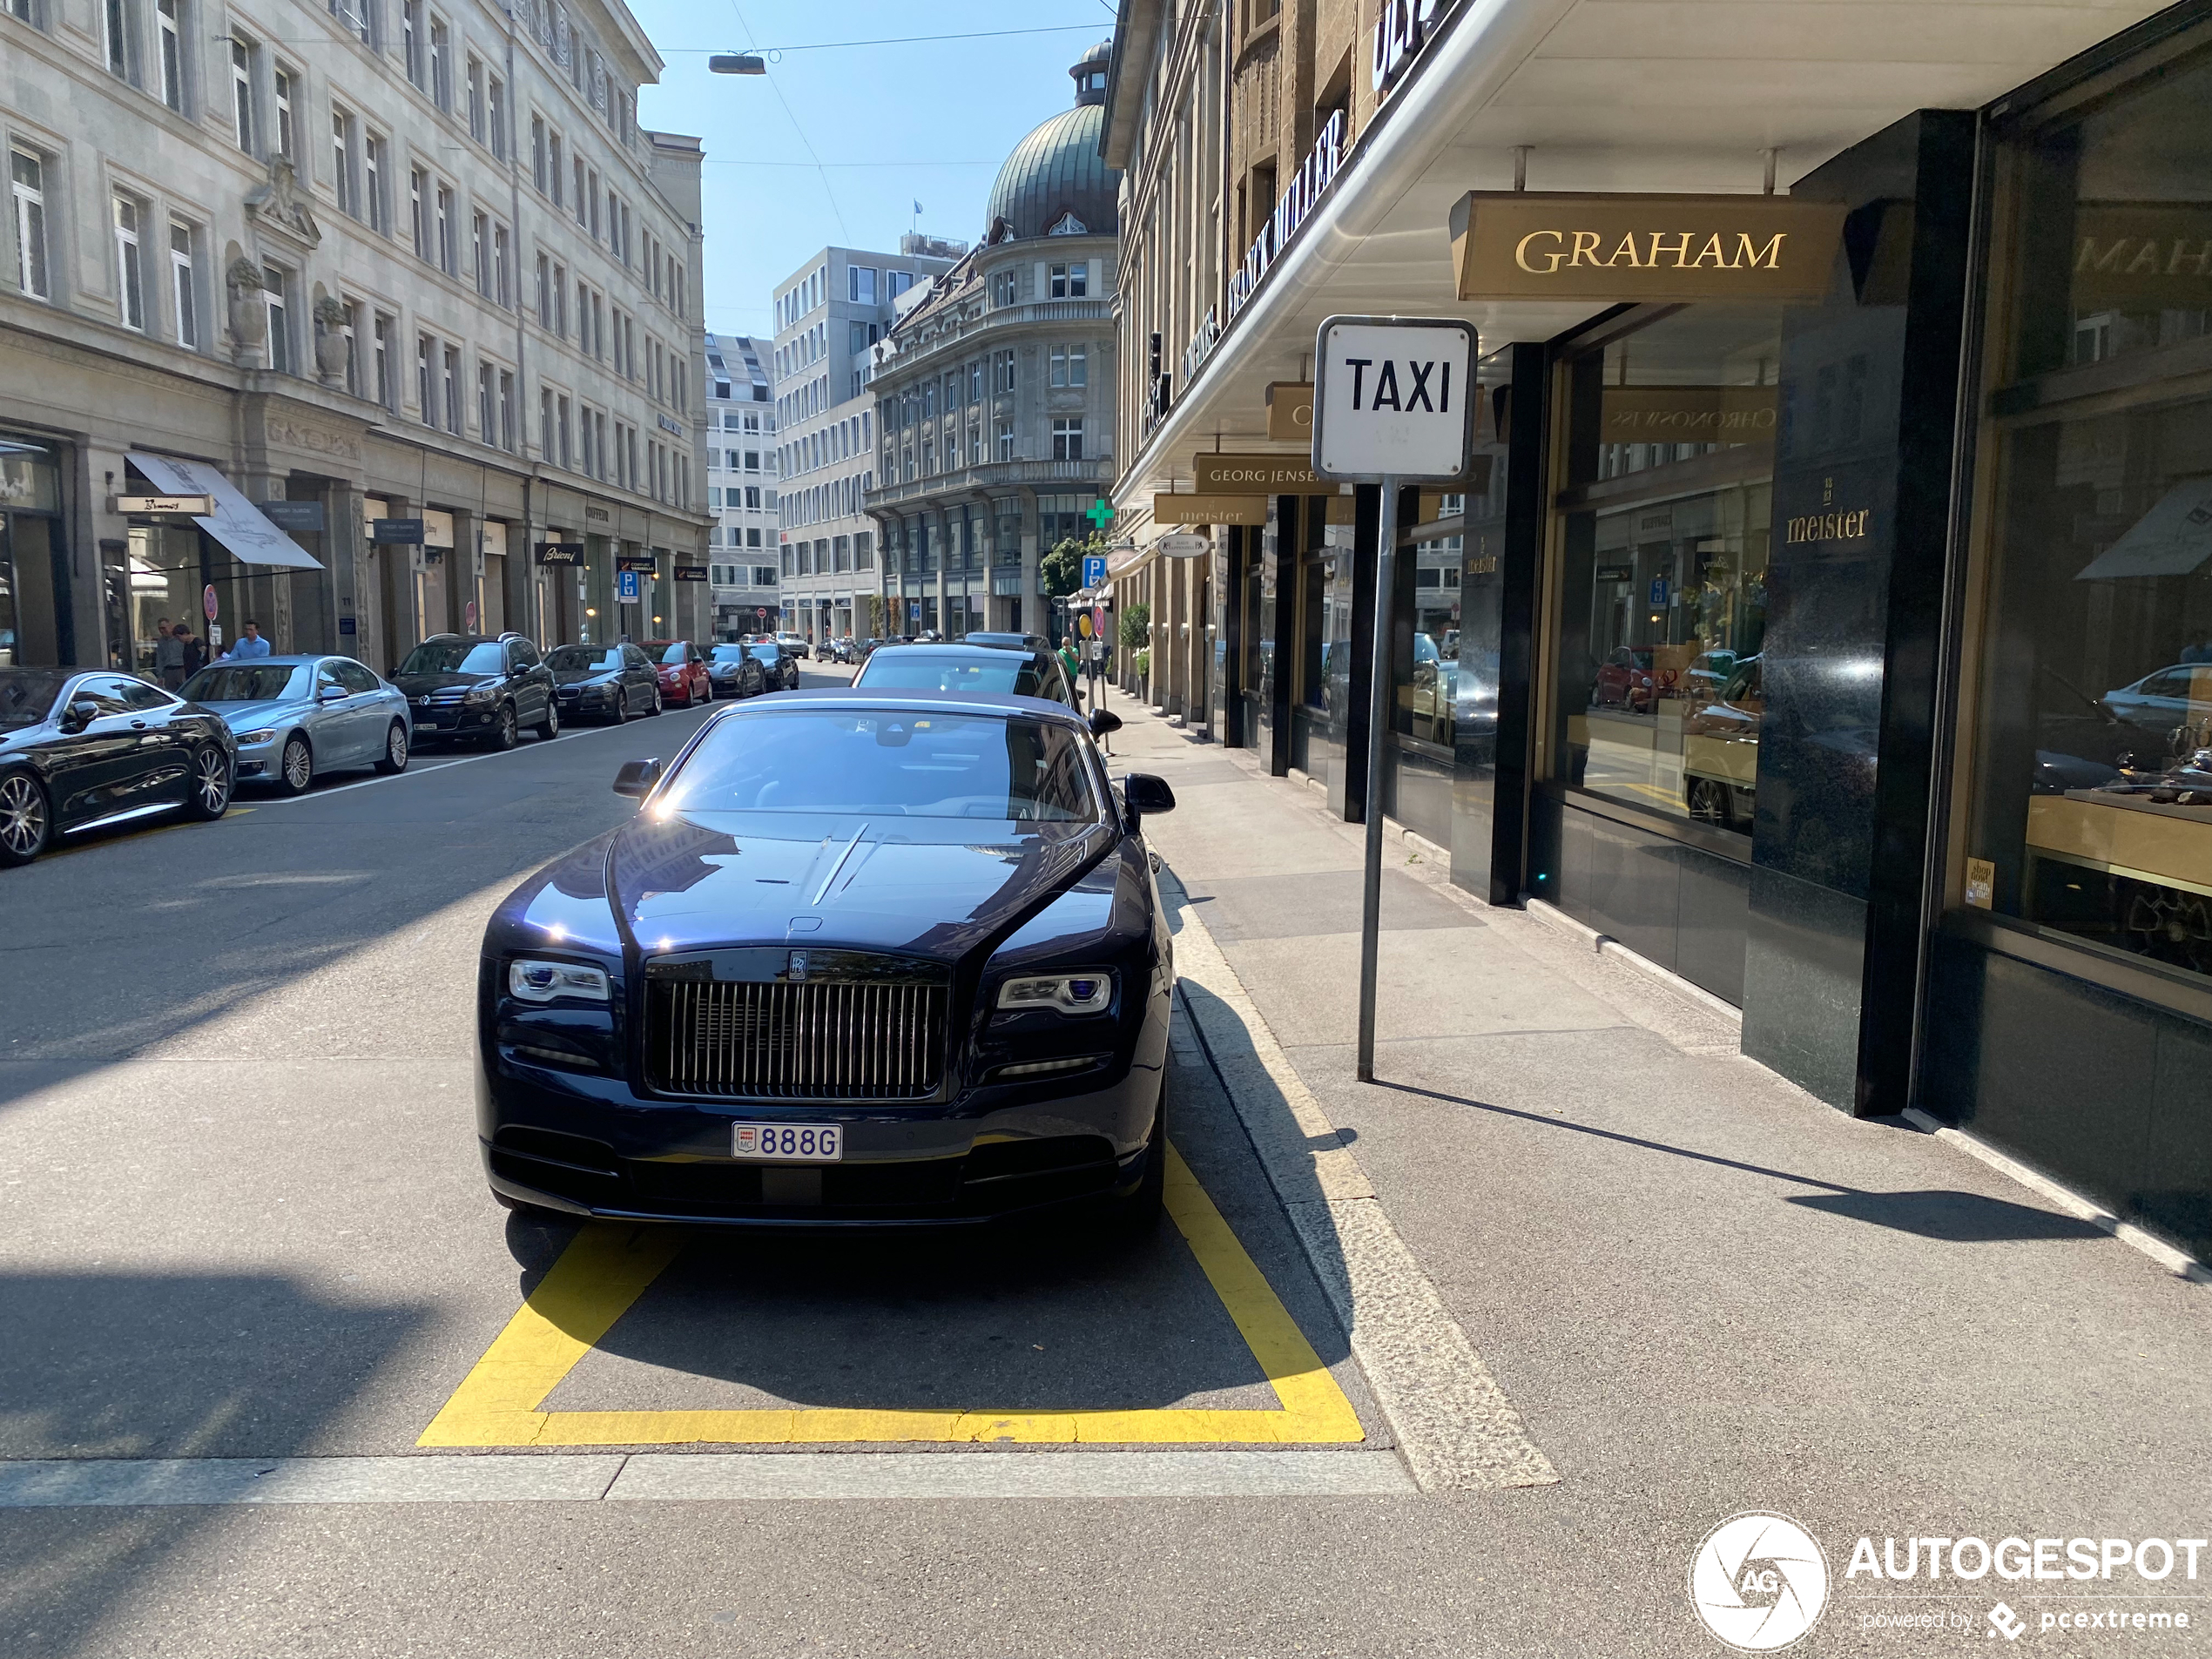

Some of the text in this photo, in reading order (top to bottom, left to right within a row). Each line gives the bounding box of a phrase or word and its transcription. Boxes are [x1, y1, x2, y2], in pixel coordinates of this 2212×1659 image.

[1229, 109, 1342, 320] FRANCK MULLER
[1514, 231, 1787, 273] GRAHAM
[1345, 358, 1450, 413] TAXI
[1211, 470, 1265, 482] GEORG
[1180, 510, 1244, 522] meister
[1787, 506, 1869, 543] meister
[543, 547, 576, 562] Brioni
[1467, 553, 1497, 574] meister
[1090, 560, 1100, 575] P
[624, 573, 632, 586] P
[1973, 860, 1991, 880] shop
[761, 1128, 836, 1155] 888G
